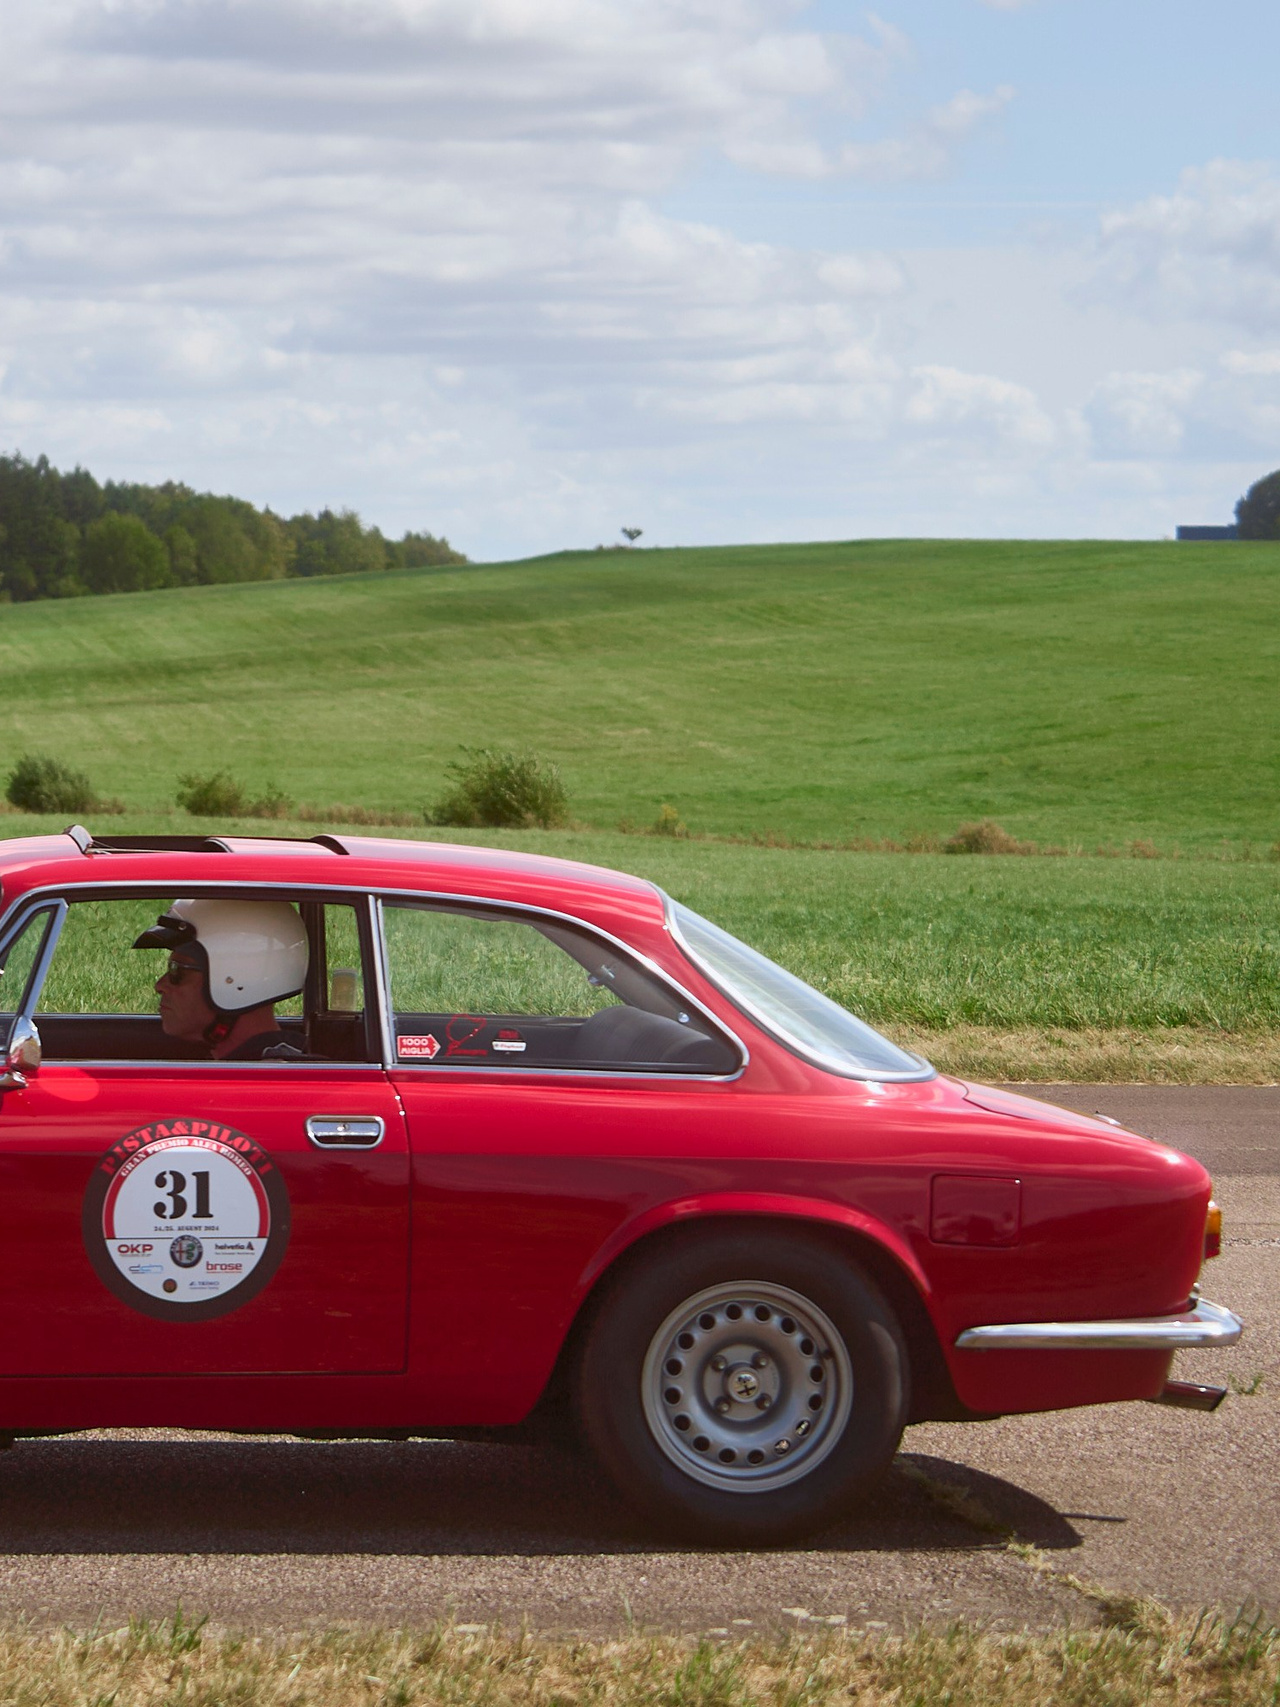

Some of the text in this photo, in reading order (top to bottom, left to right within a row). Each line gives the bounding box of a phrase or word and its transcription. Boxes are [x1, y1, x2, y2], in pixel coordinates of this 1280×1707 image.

[401, 1038, 429, 1046] 1000
[400, 1047, 431, 1055] MIGLIA
[100, 1121, 274, 1177] PISTA&PILOTI
[120, 1138, 253, 1178] GRAN PREMIO ALFA ROMEO
[153, 1170, 214, 1220] 31
[117, 1243, 154, 1254] OKP
[214, 1243, 245, 1251] helvetia
[206, 1261, 243, 1271] brose
